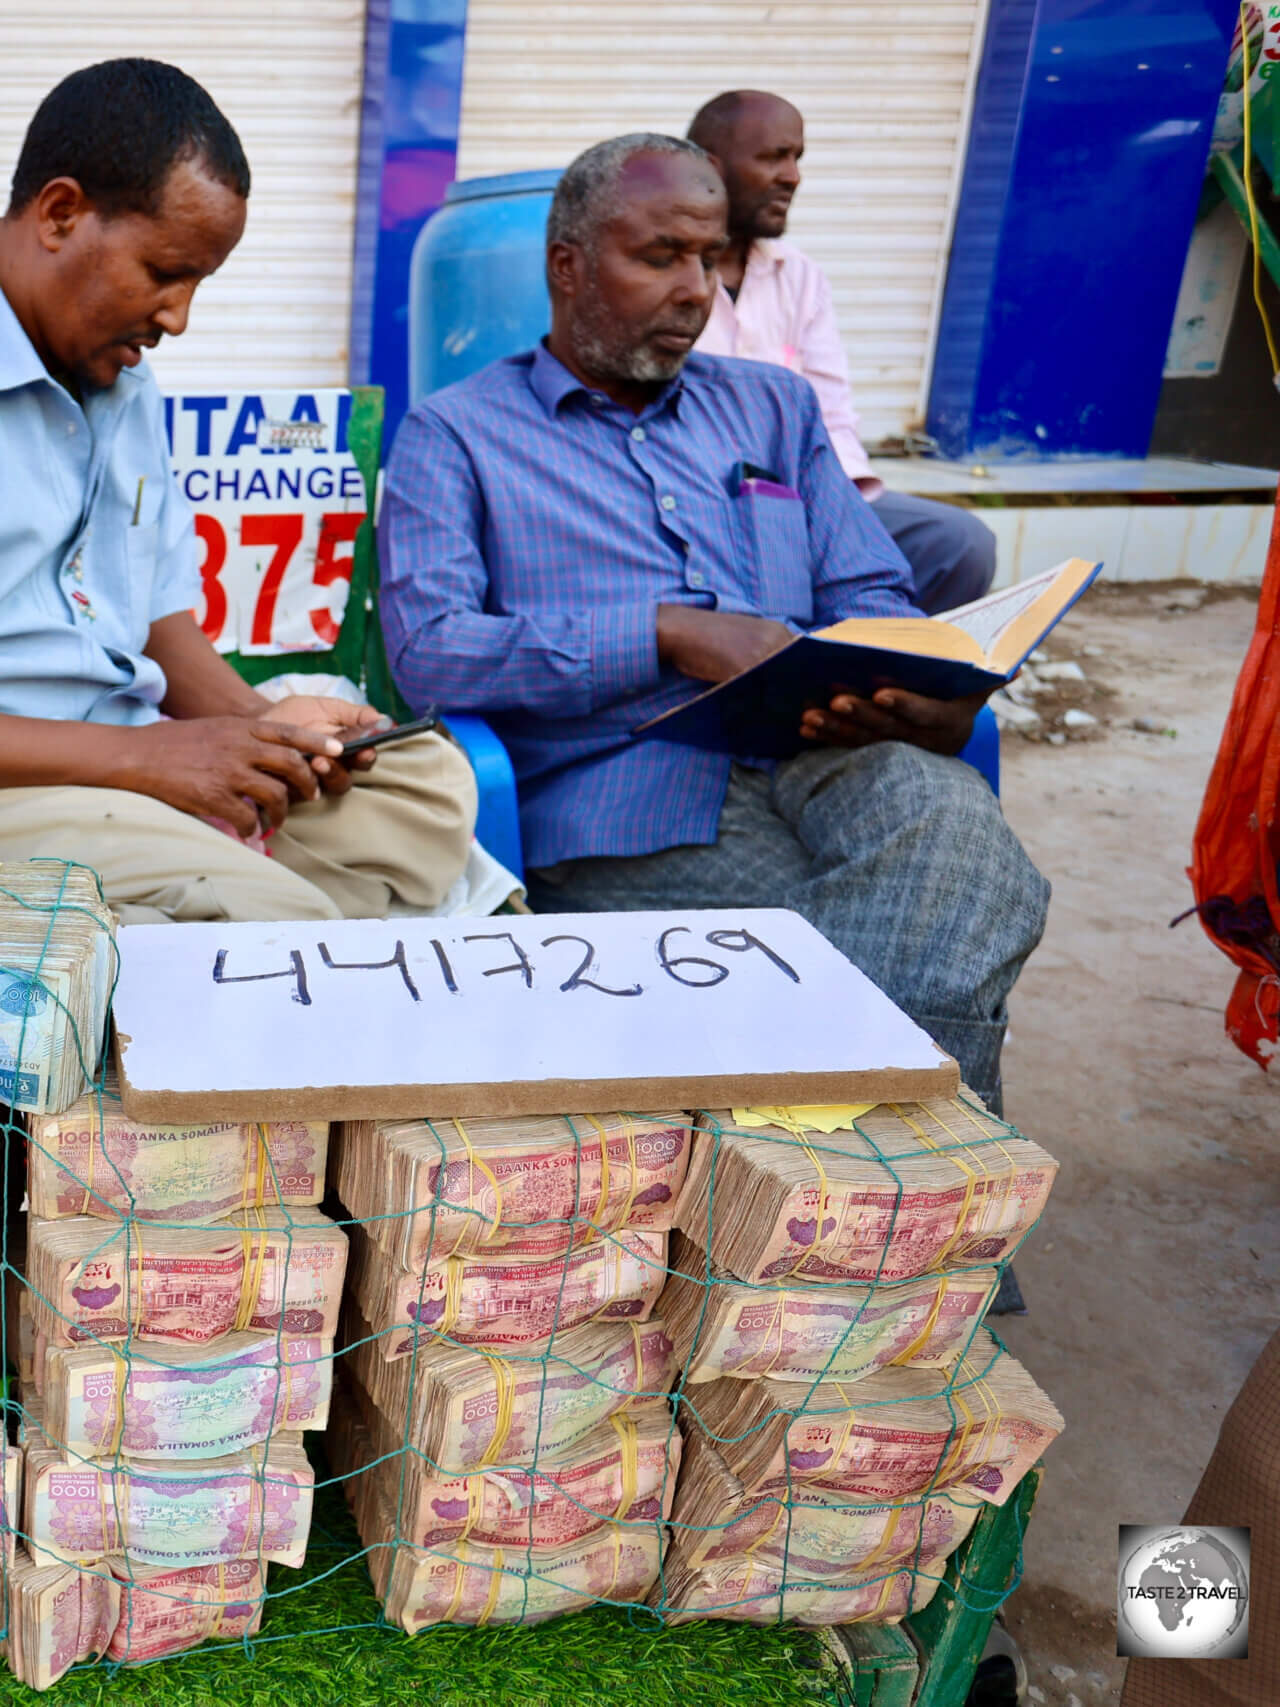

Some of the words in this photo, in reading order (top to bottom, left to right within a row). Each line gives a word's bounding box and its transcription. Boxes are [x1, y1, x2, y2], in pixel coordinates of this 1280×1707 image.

[173, 467, 363, 501] CHANGE
[120, 1129, 178, 1142] BAANKA
[635, 1138, 676, 1155] 1000
[496, 1159, 550, 1176] BAANKA
[553, 1143, 624, 1168] SOMALILND
[86, 1384, 131, 1399] 100
[463, 1401, 498, 1421] 000
[51, 1485, 96, 1498] 1000
